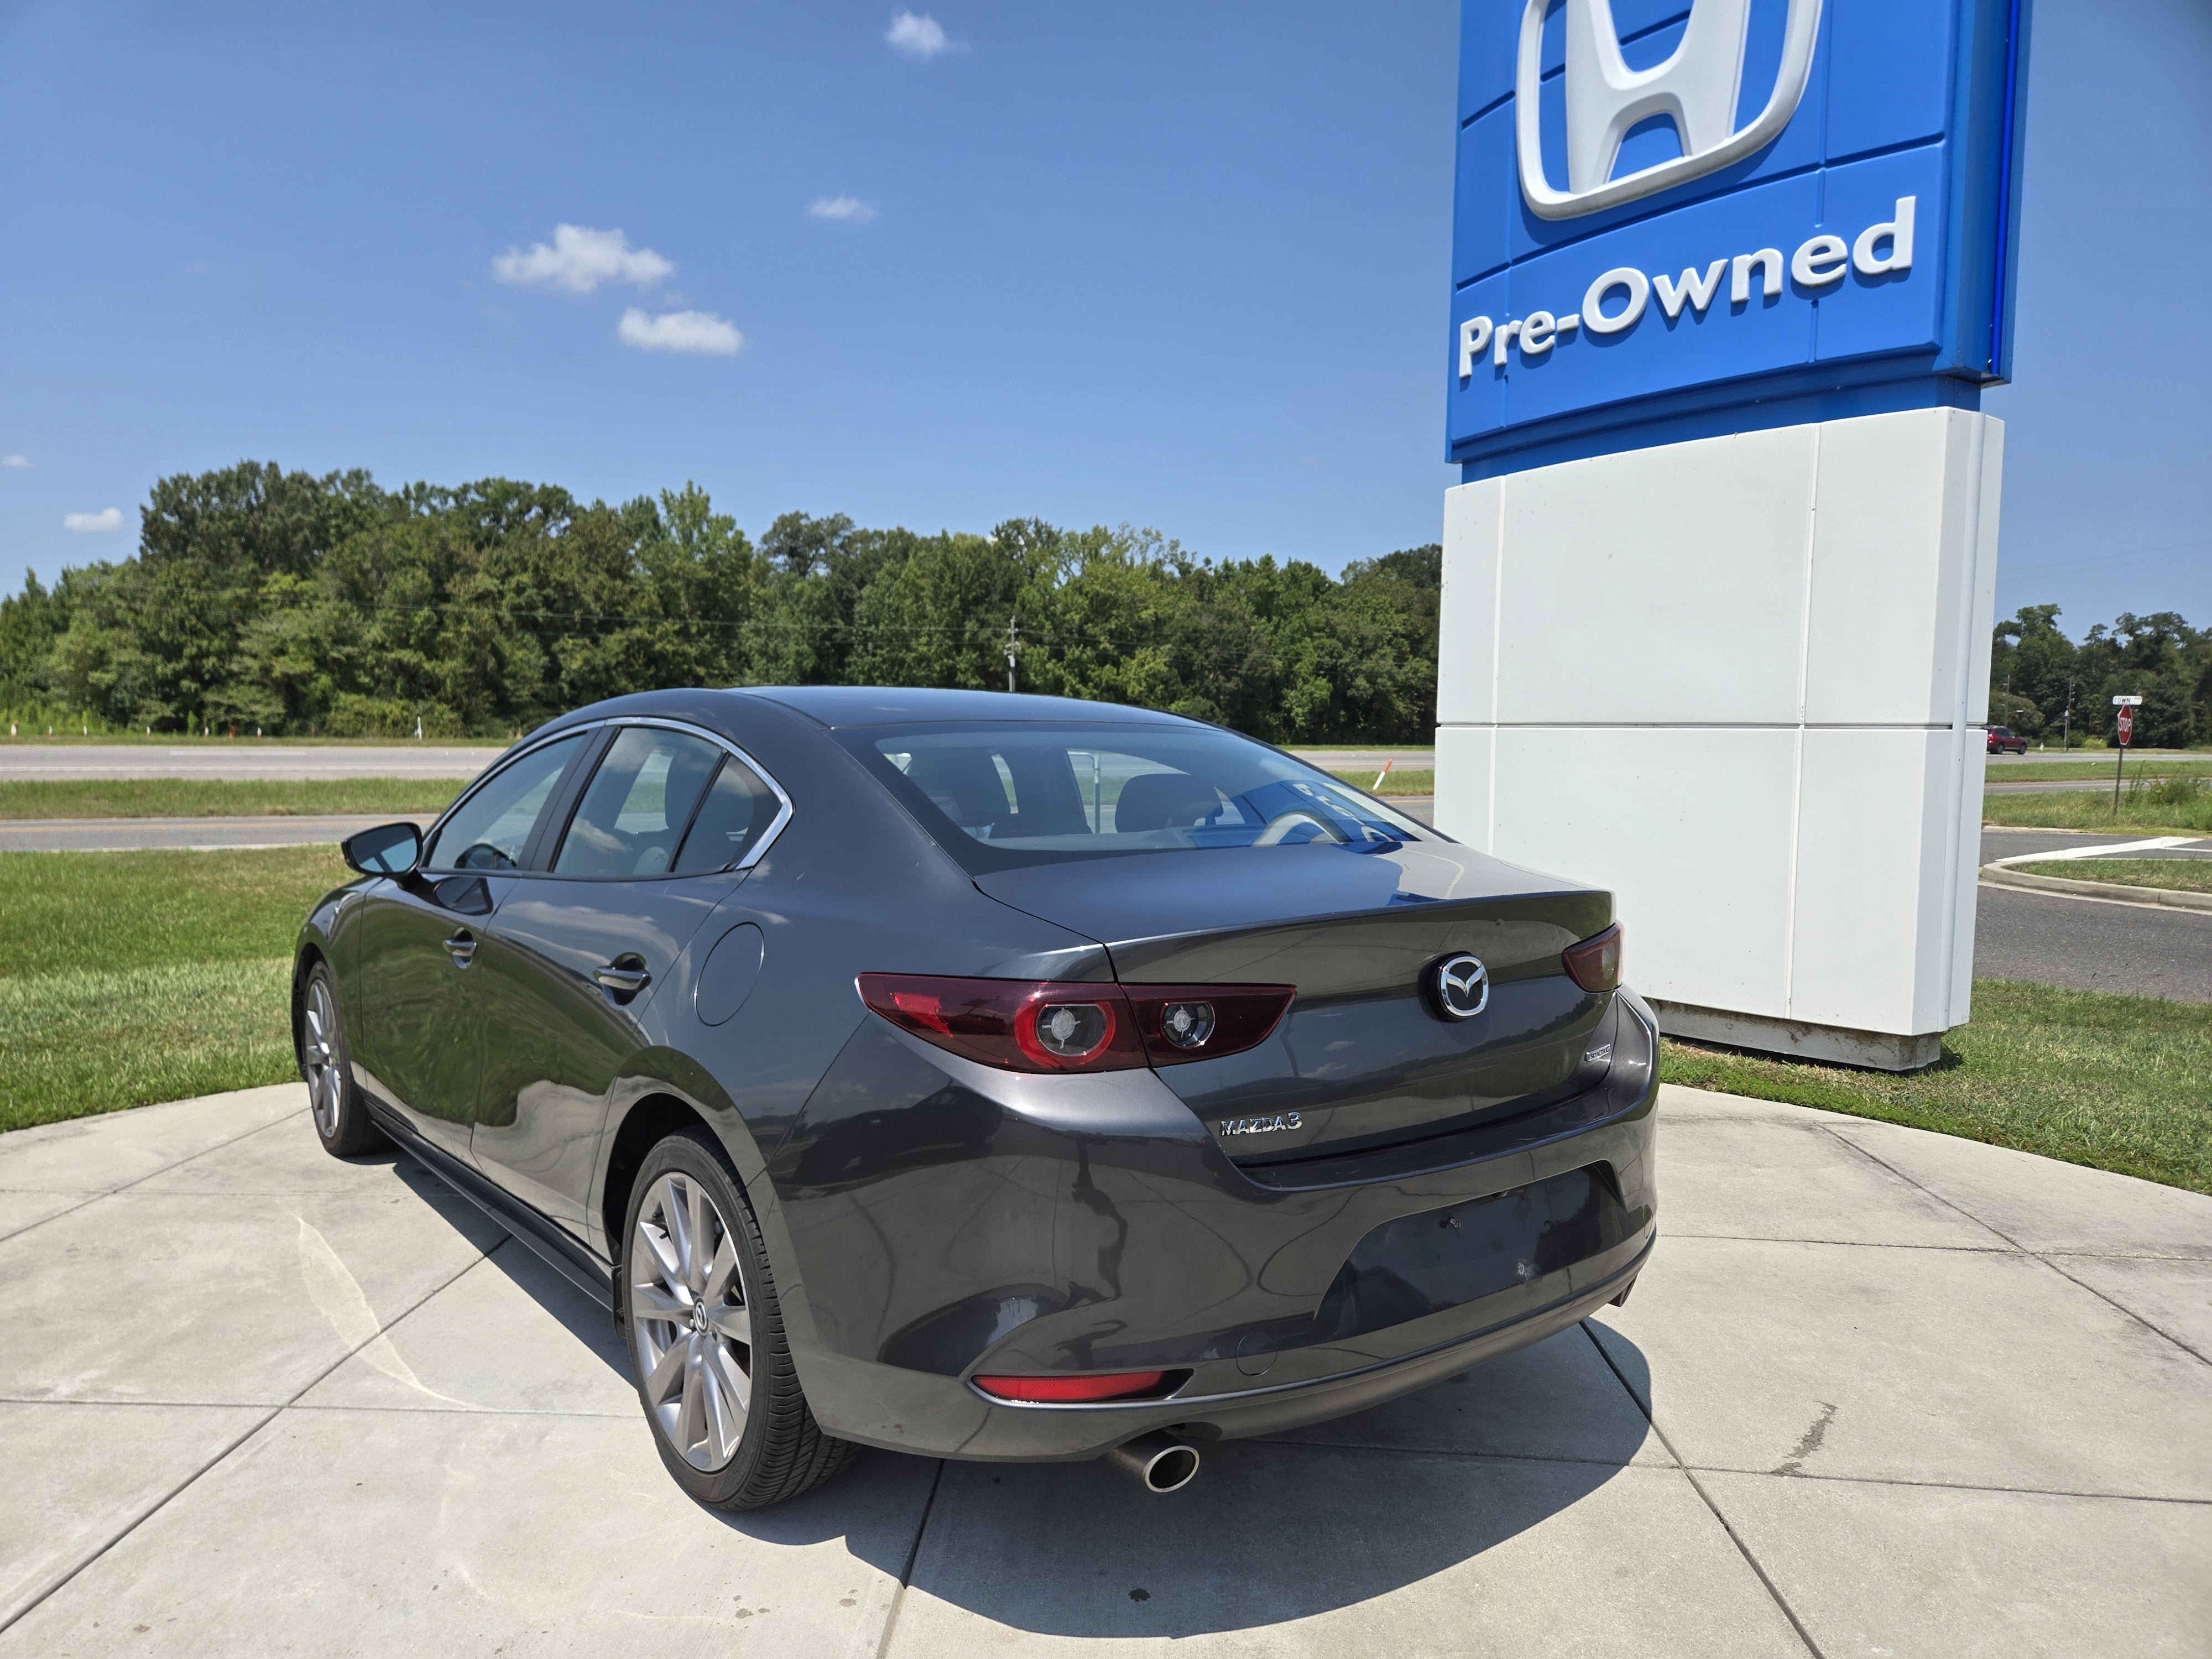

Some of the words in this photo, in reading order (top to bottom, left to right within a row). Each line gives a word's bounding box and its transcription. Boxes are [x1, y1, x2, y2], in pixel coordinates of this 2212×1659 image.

[1459, 196, 1916, 378] Pre-Owned
[2119, 717, 2131, 732] STOP
[1220, 1112, 1302, 1136] MAZDA3
